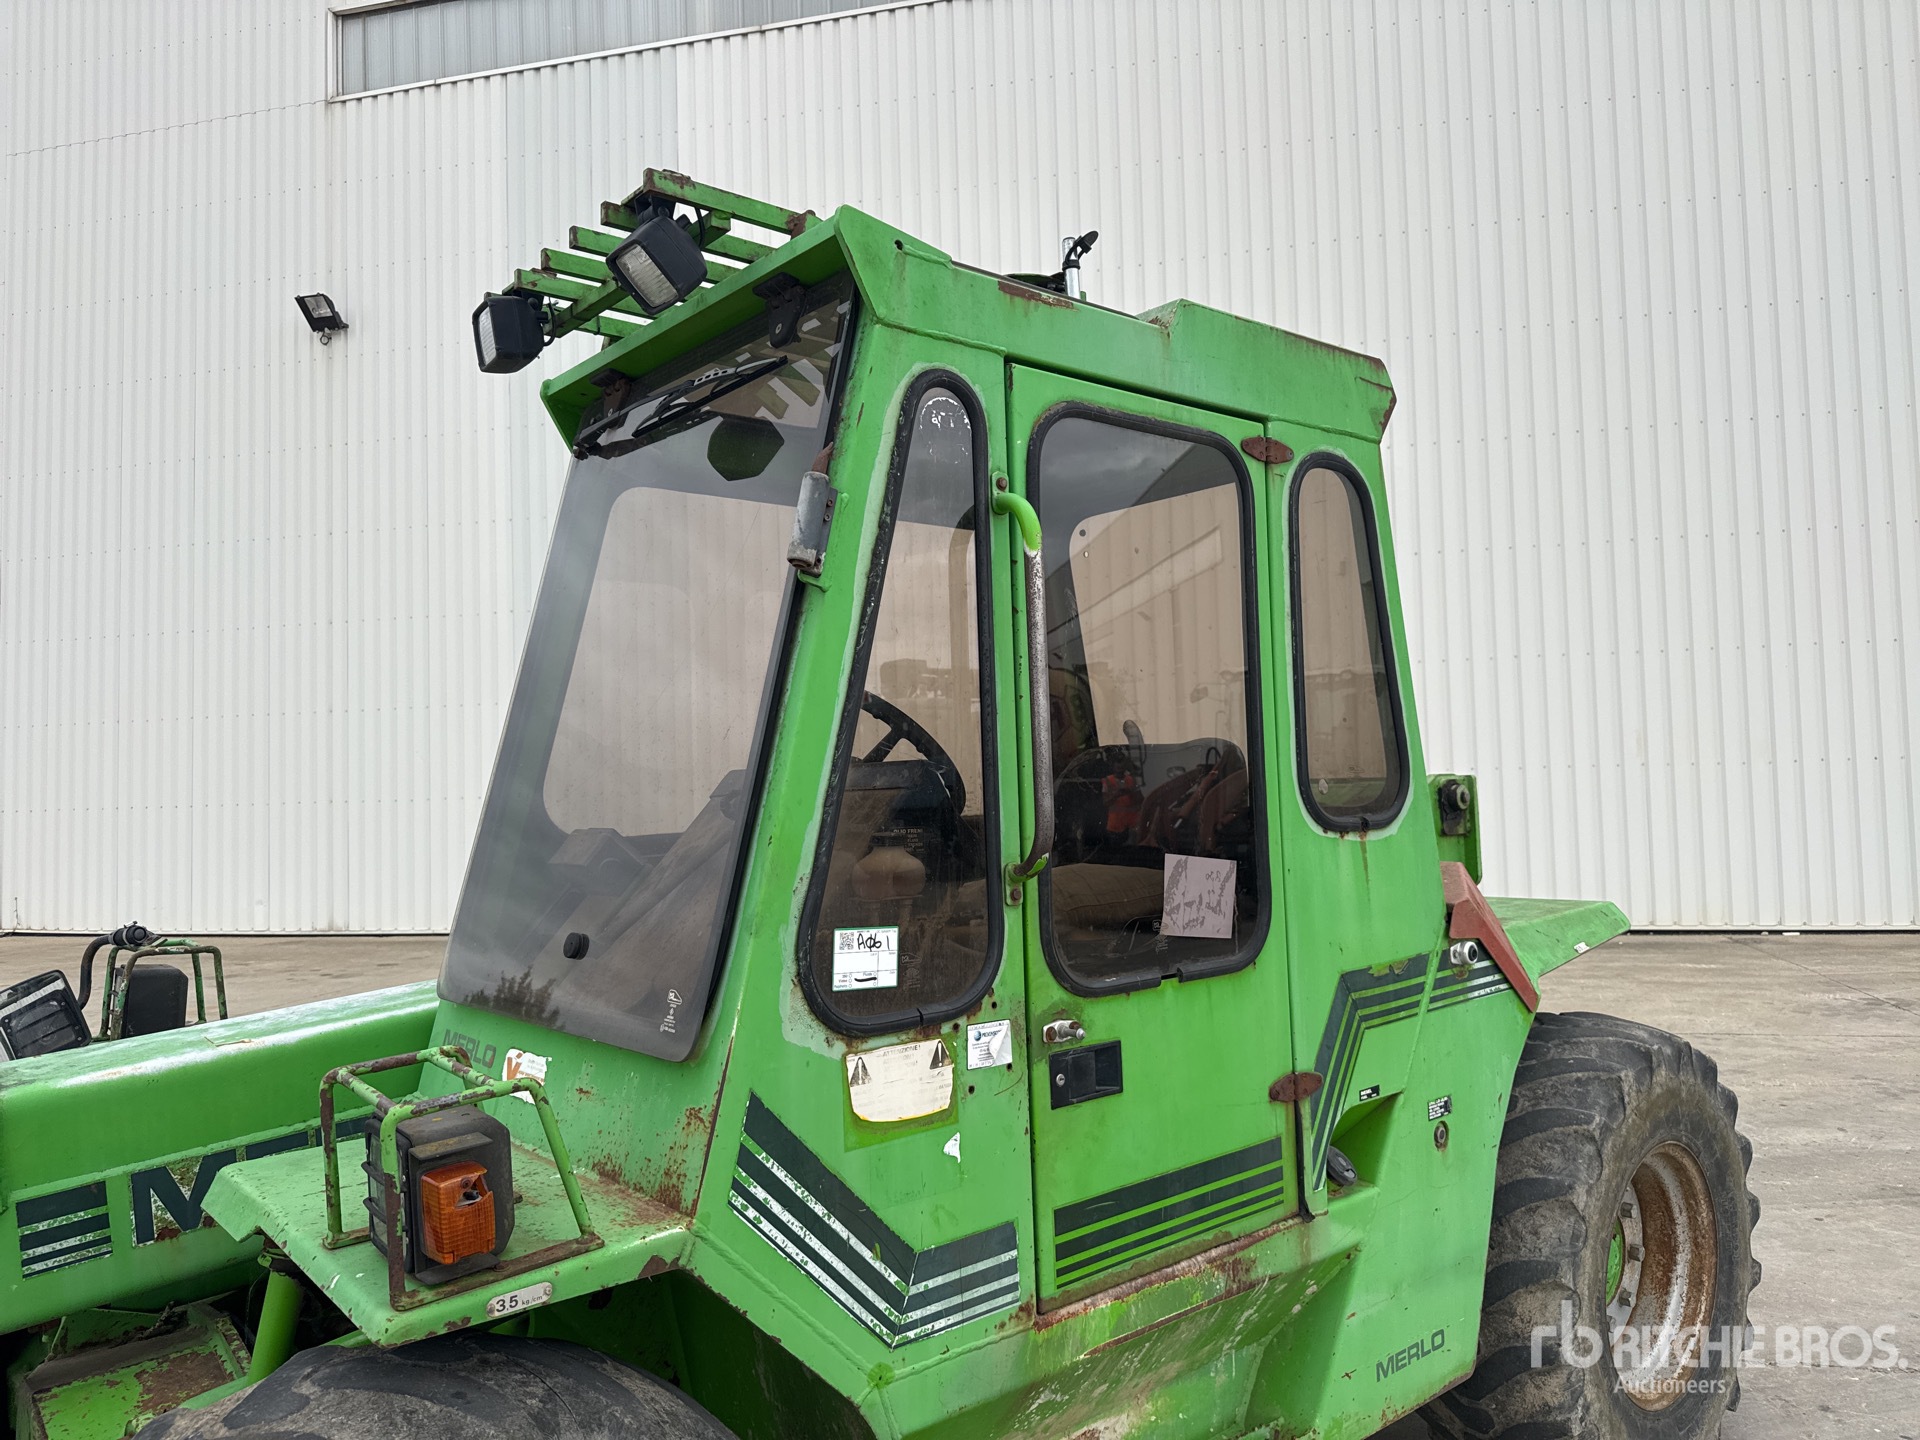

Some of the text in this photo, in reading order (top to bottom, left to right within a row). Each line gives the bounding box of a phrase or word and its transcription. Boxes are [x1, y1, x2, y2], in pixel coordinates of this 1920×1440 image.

[442, 1029, 497, 1069] MERLO
[496, 1294, 519, 1313] 3,5
[1375, 1328, 1445, 1383] MERLO
